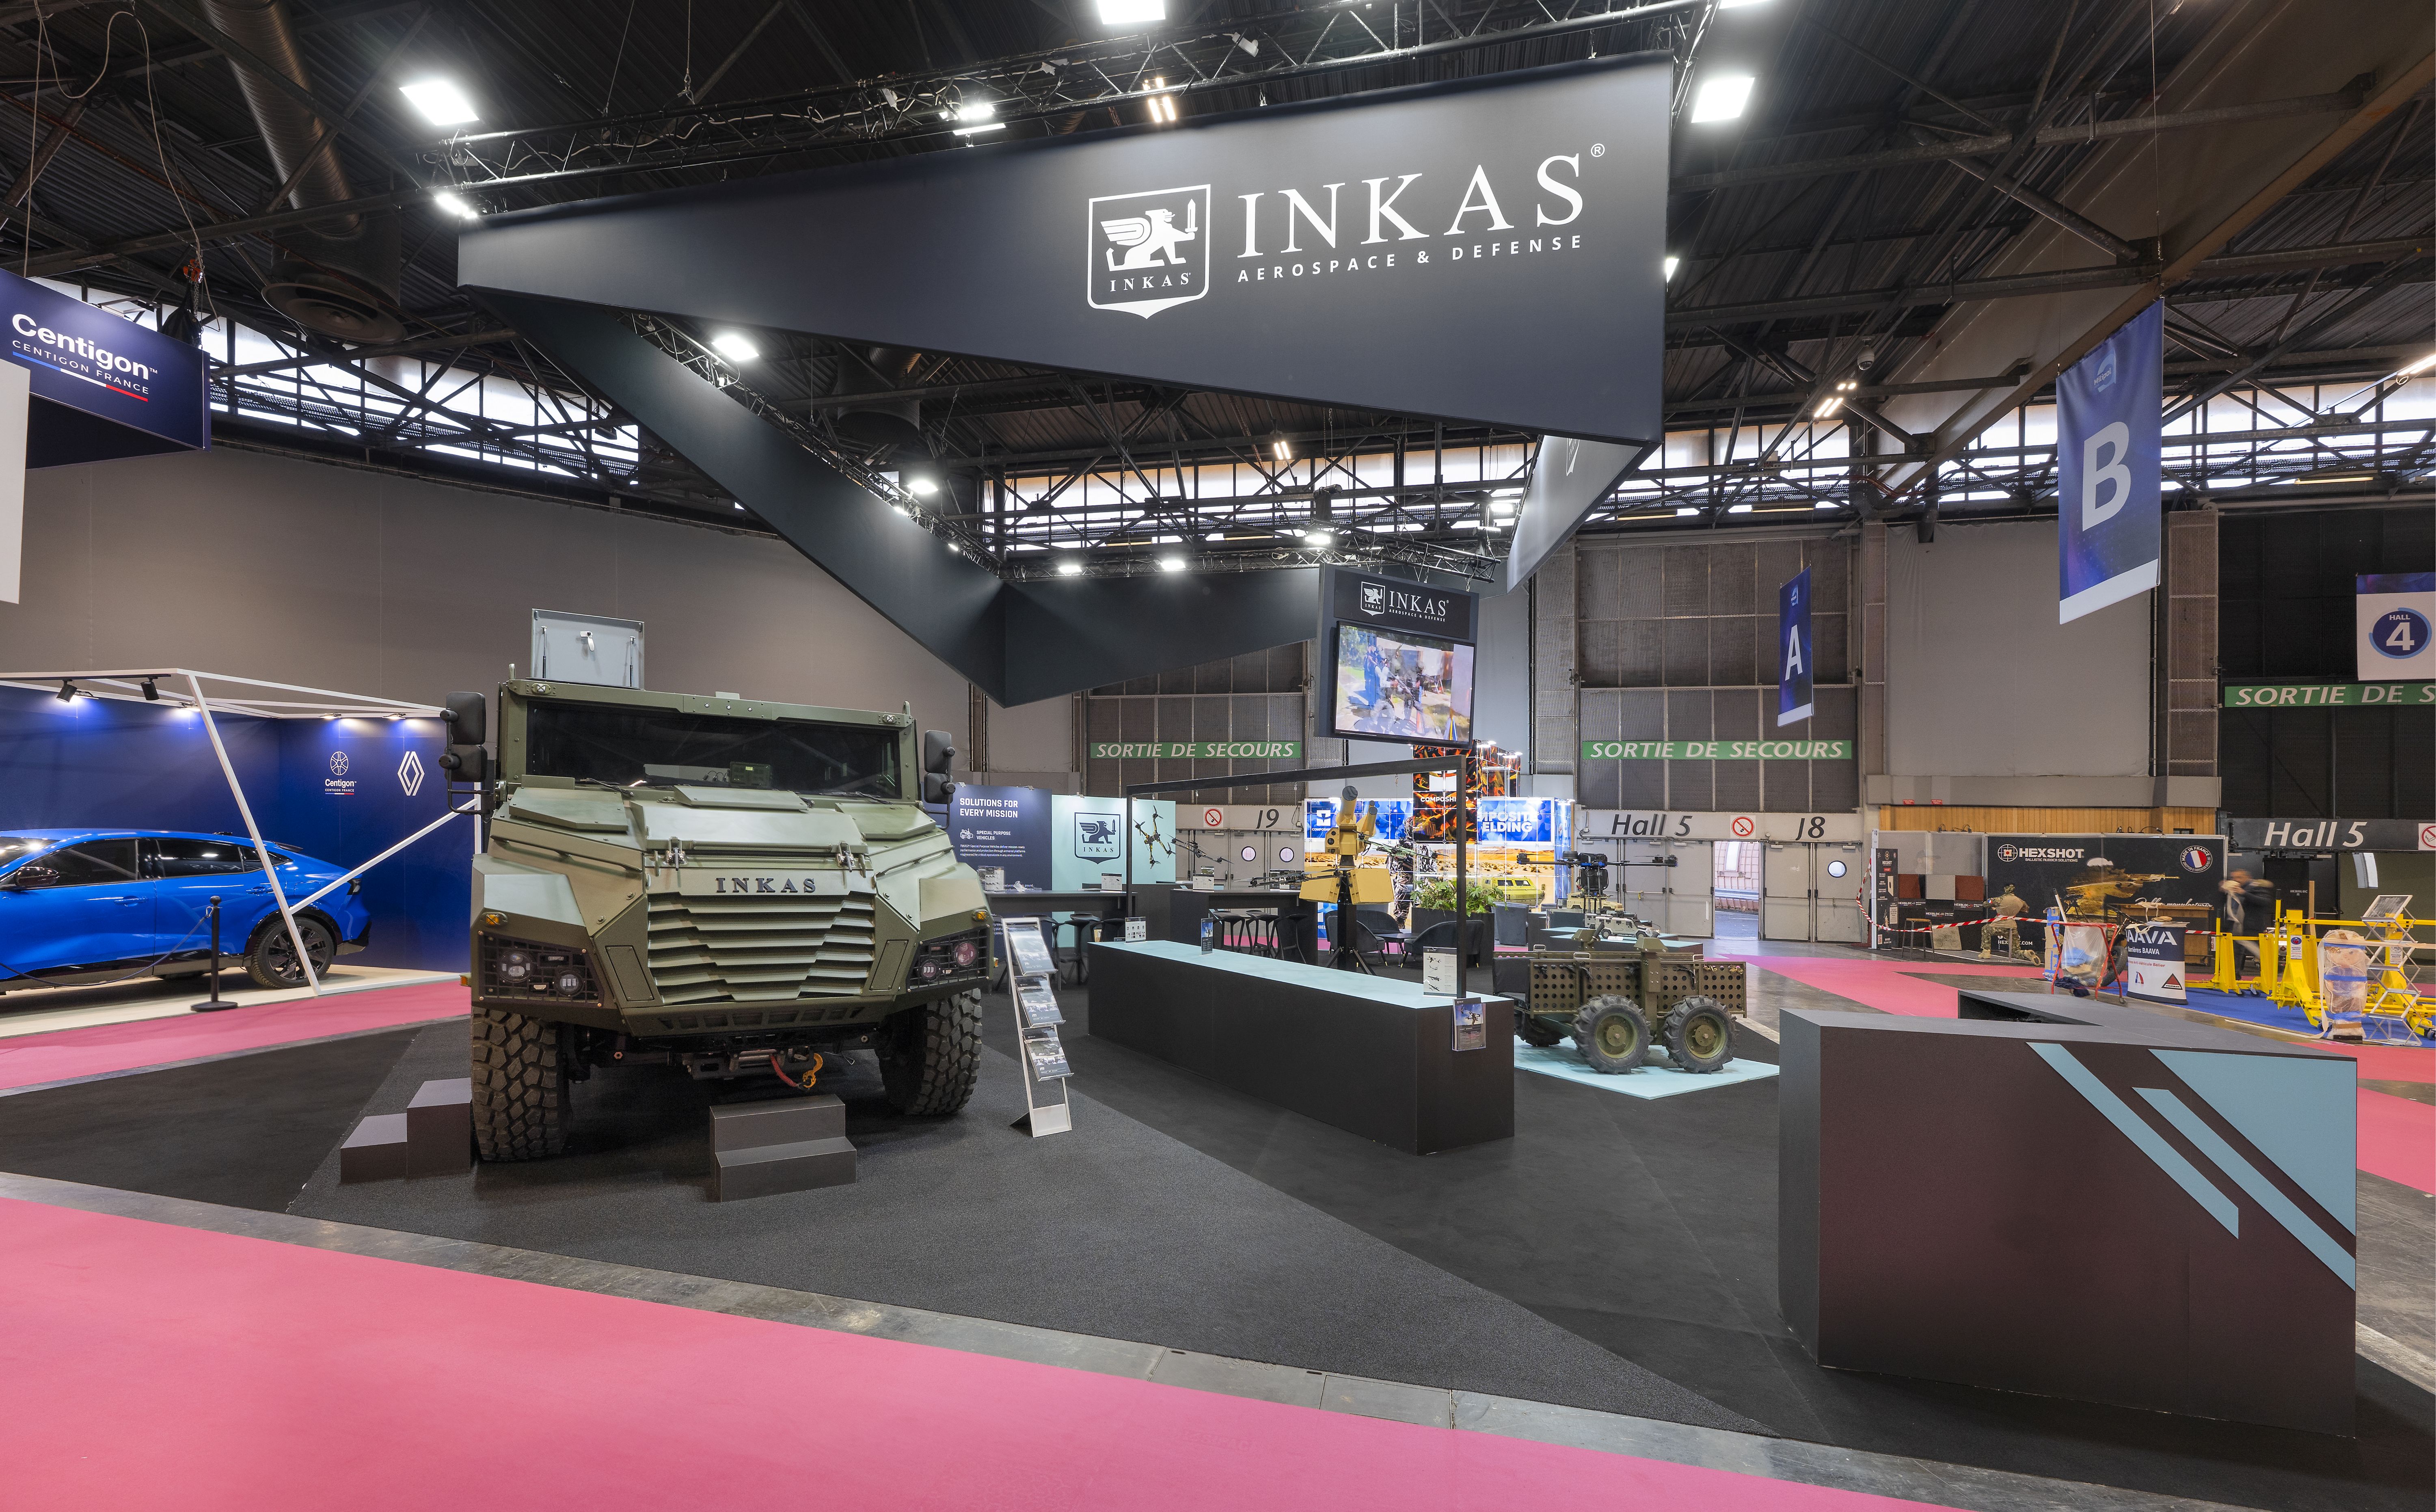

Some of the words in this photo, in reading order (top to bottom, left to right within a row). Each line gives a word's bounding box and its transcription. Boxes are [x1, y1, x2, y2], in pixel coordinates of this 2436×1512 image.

[1237, 253, 1396, 283] AEROSPACE
[1417, 250, 1430, 264] &
[1452, 235, 1581, 261] DEFENSE
[1109, 272, 1190, 292] INKAS
[12, 340, 89, 373] CENTIGON
[96, 369, 149, 395] FRANCE
[2094, 367, 2112, 386] Milipol
[2082, 421, 2131, 532] B
[1389, 609, 1417, 617] AEROSPACE
[2386, 622, 2414, 651] 4
[1785, 624, 1803, 681] A
[2235, 687, 2346, 705] SORTIE
[2361, 686, 2404, 703] DE
[1096, 744, 1162, 757] SORTIE
[1171, 744, 1197, 757] DE
[1205, 743, 1294, 757] SECOURS
[1590, 742, 1674, 758] SORTIE
[1685, 742, 1719, 758] DE
[1729, 741, 1843, 758] SECOURS
[959, 798, 1002, 807] SOLUTIONS
[960, 808, 985, 816] EVERY
[986, 810, 1018, 818] MISSION
[1256, 809, 1279, 829] J9
[1482, 822, 1533, 832] ELDING
[1611, 814, 1667, 836] Hall
[1675, 815, 1693, 837] 5
[1795, 816, 1825, 841] J8
[2264, 821, 2338, 847] Hall
[2342, 821, 2367, 847] 5
[2194, 847, 2210, 856] FRANCE
[715, 877, 816, 894] INKAS
[2125, 929, 2177, 946] AAVA
